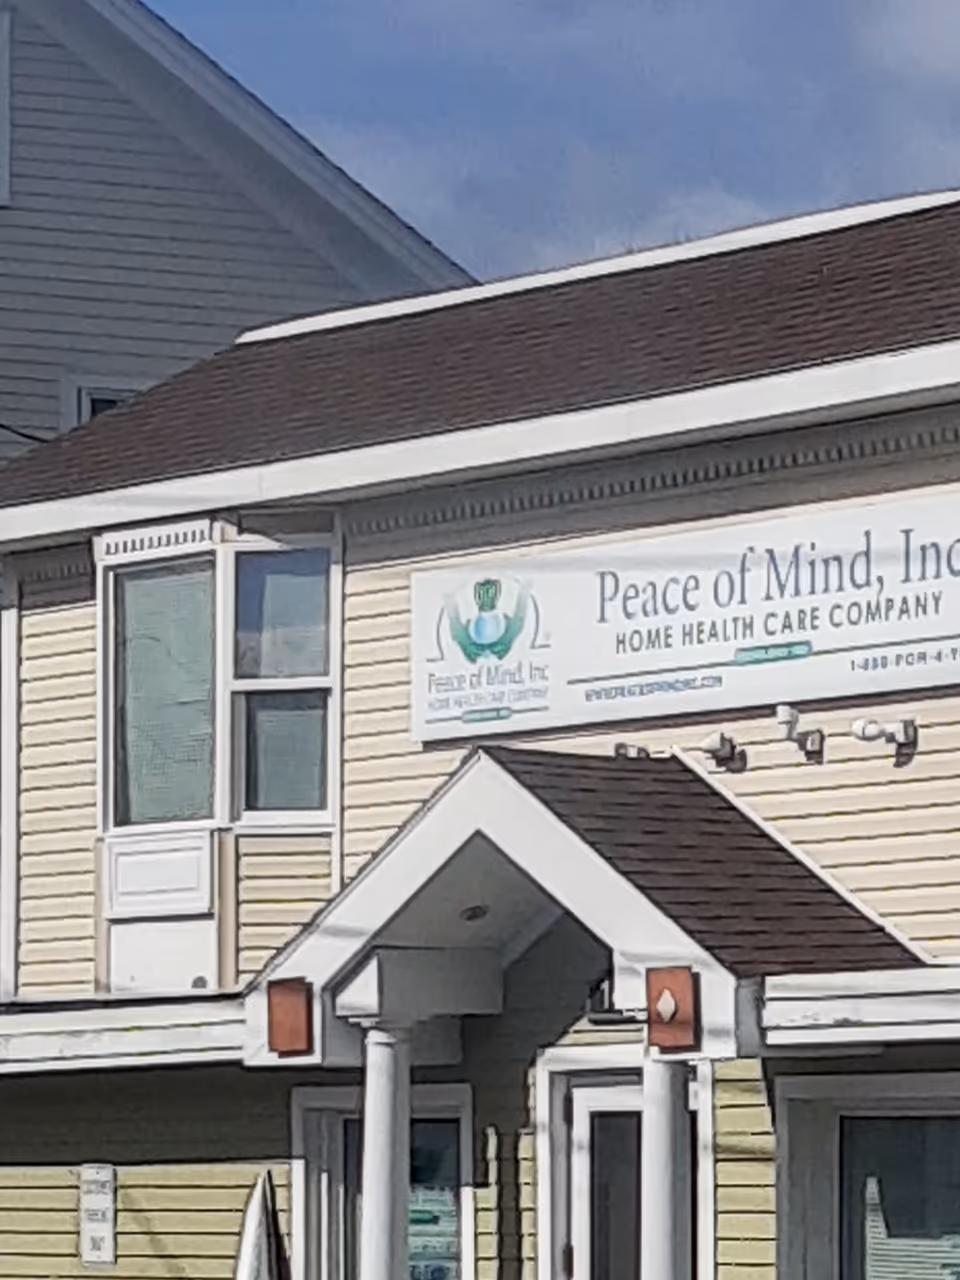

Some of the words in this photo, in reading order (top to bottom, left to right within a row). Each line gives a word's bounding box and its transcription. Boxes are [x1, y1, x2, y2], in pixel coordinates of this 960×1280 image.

[596, 570, 700, 624] Peace
[713, 545, 757, 608] of
[761, 529, 884, 603] Mind,
[615, 625, 673, 655] HOME
[682, 614, 755, 647] HEALTH
[763, 606, 820, 637] CARE
[828, 590, 943, 628] COMPANY
